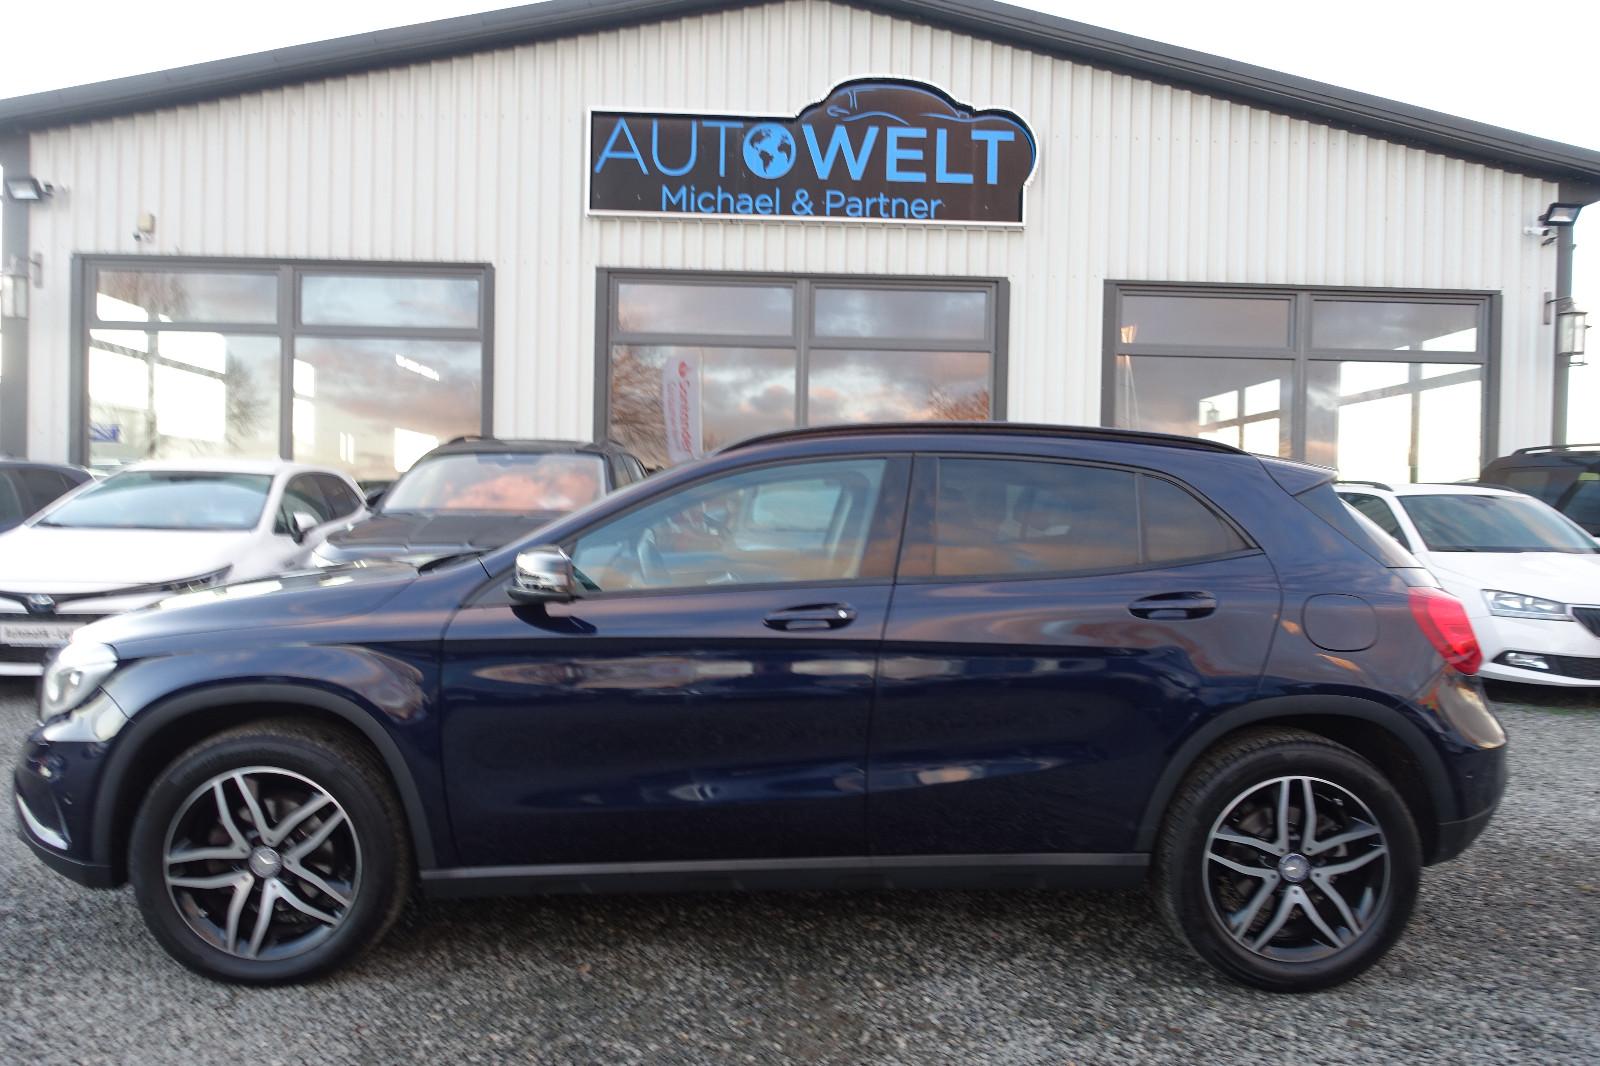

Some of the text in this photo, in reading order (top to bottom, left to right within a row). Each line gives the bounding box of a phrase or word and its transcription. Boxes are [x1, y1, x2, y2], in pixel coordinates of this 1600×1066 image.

[661, 184, 942, 220] Michael & Partner
